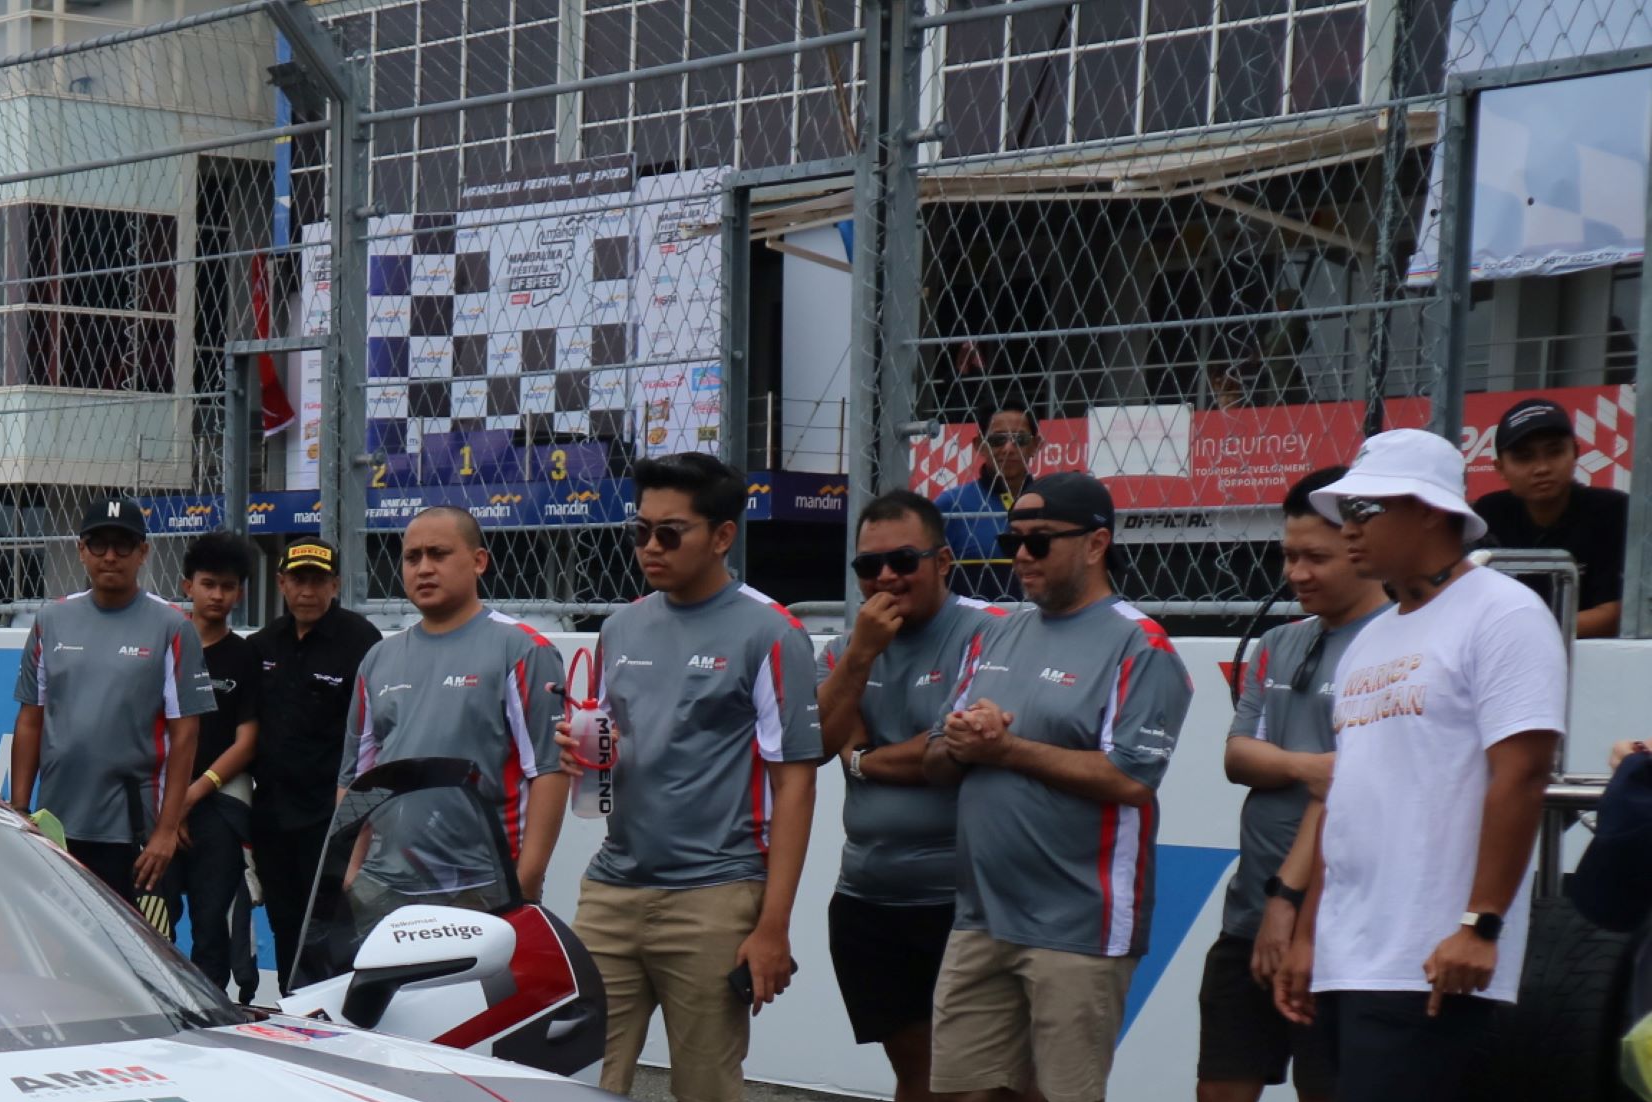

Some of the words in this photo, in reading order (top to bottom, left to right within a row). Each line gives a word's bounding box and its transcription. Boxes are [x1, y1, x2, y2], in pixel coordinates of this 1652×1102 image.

[1195, 432, 1314, 465] injourney
[459, 446, 474, 477] 1
[550, 449, 568, 481] 3
[1196, 466, 1237, 476] TOURISM
[1240, 463, 1312, 474] DEVELOPMENT
[1219, 476, 1286, 487] CORPORATION
[107, 501, 121, 518] N
[545, 501, 589, 516] mandiri
[795, 494, 841, 510] mandiri
[469, 504, 511, 518] mandiri
[595, 717, 612, 815] MORENO
[393, 922, 484, 944] Prestige
[10, 1065, 170, 1095] AMM
